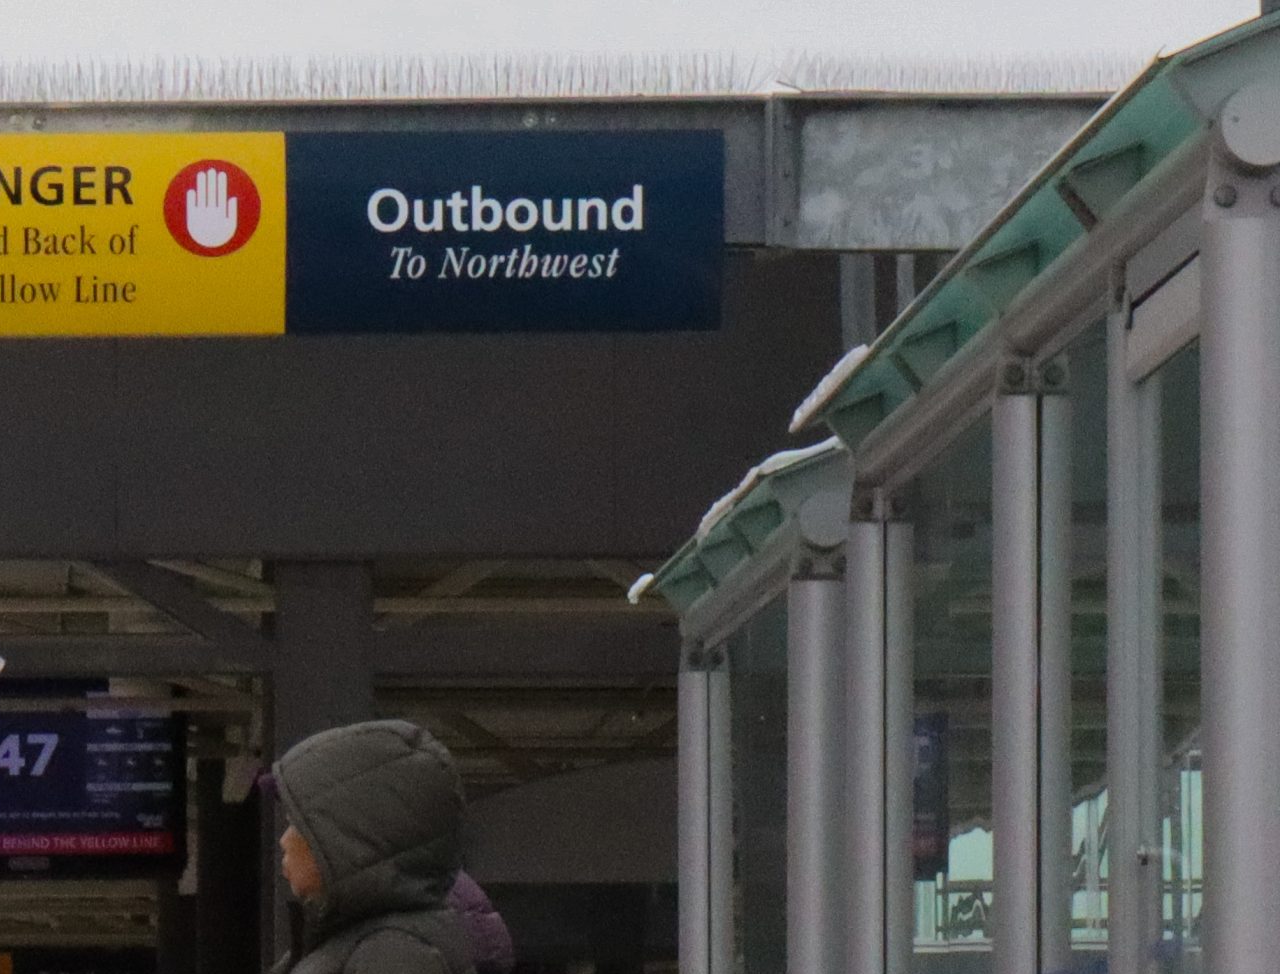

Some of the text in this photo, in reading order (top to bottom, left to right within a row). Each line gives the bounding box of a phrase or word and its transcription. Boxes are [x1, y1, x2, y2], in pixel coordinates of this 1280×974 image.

[367, 184, 643, 233] Outbound
[22, 225, 97, 255] Back
[107, 225, 138, 255] of
[389, 244, 620, 280] To Northwest
[74, 274, 138, 304] Line
[2, 836, 49, 850] BEHIND
[53, 836, 78, 850] THE
[80, 835, 130, 850] YELLOW
[132, 835, 162, 849] LINE
